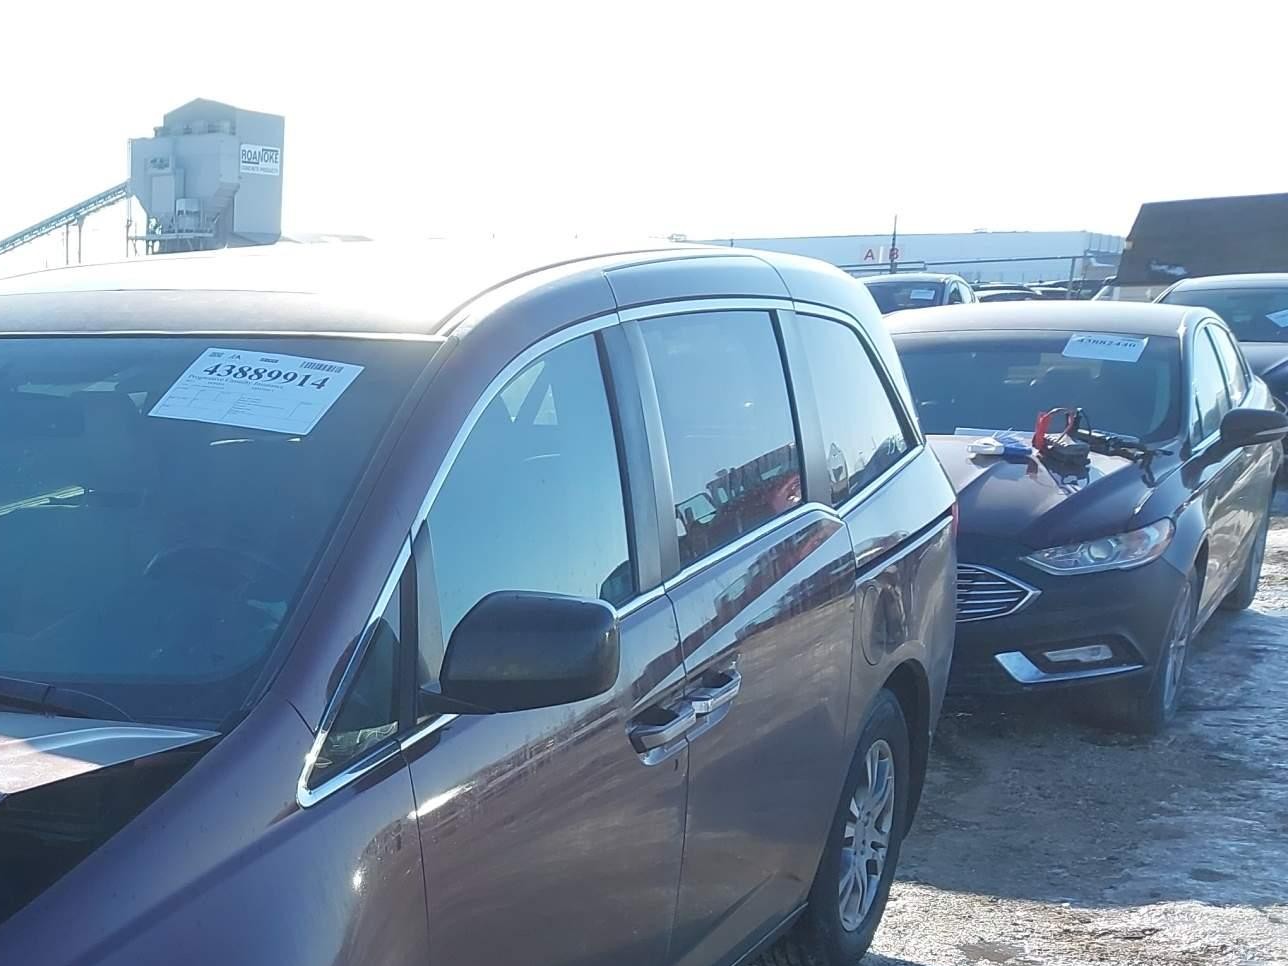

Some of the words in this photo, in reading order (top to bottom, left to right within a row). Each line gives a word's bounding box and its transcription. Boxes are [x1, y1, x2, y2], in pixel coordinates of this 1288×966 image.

[241, 149, 279, 164] ROANOKE
[864, 249, 875, 261] A
[889, 247, 900, 261] B
[203, 363, 330, 390] 43889914
